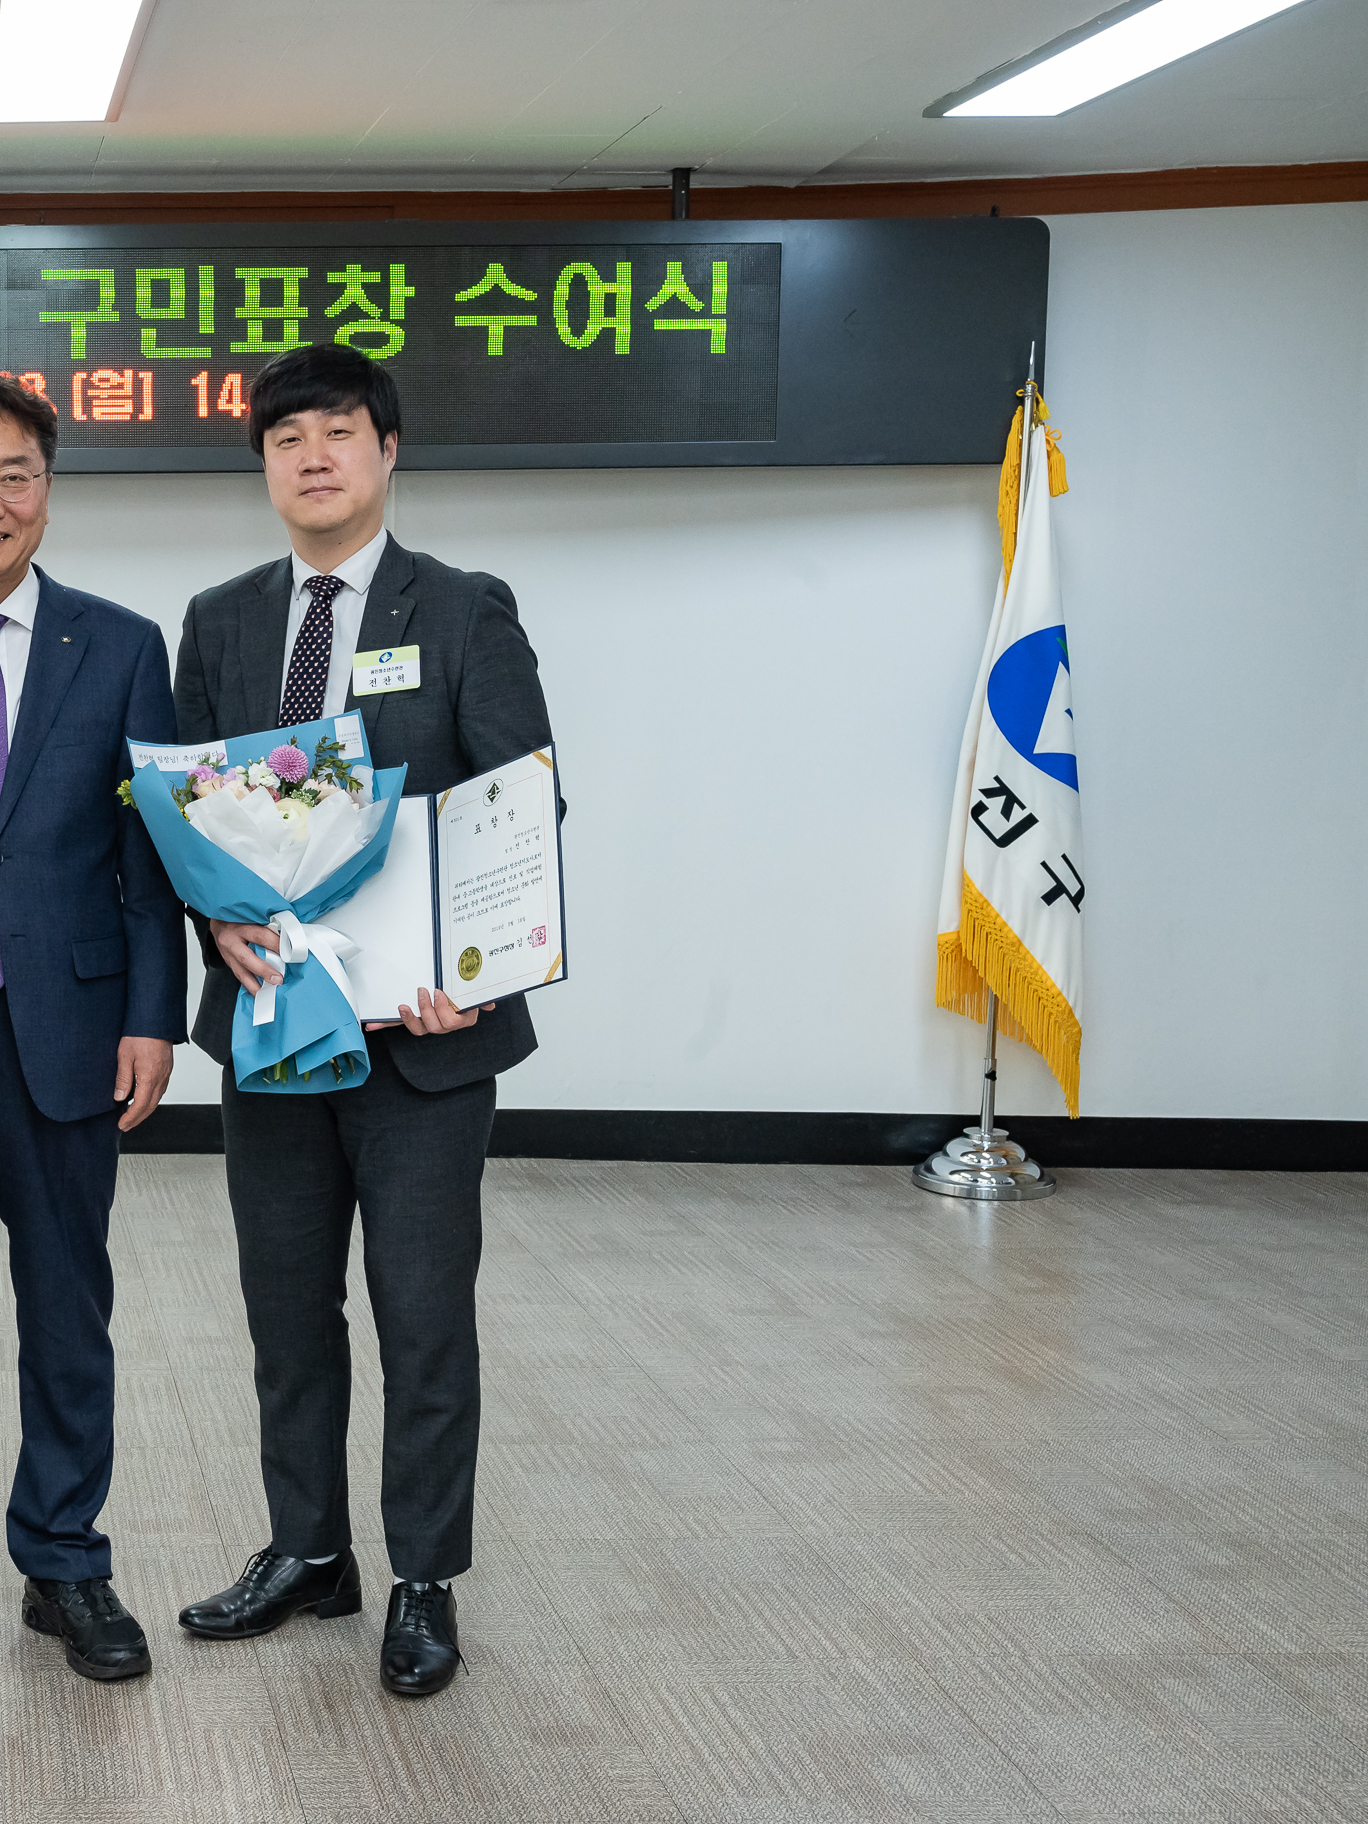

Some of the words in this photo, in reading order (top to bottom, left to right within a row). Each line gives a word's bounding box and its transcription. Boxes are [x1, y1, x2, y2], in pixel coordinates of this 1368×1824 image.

[38, 263, 415, 360] 구민표창
[454, 260, 727, 355] 수여식
[71, 368, 154, 422] [월]
